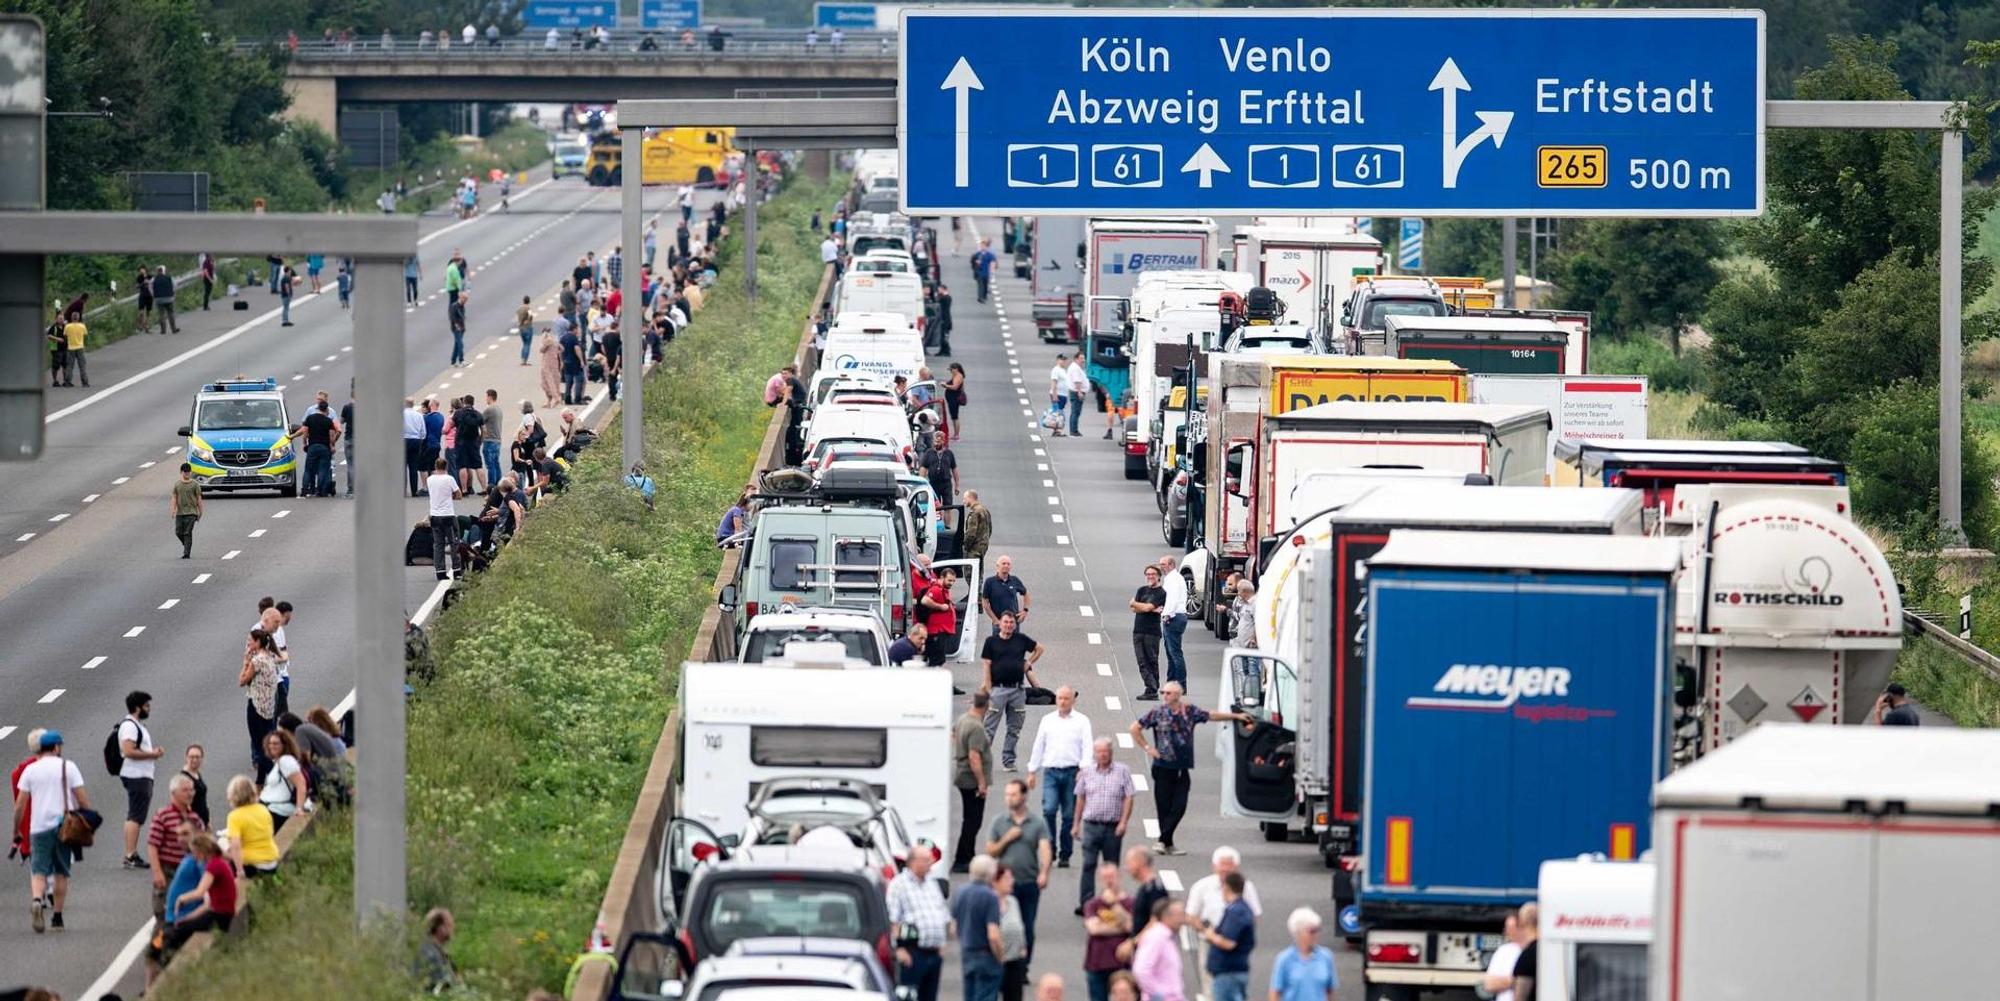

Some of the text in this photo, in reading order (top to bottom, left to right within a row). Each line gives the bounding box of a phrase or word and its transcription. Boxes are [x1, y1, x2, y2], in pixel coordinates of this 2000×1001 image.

[1081, 36, 1331, 73] Köln Venlo
[1536, 78, 1714, 113] Erftstadt
[1047, 89, 1365, 134] Abzweig Erfttal
[1038, 153, 1048, 178] 1
[1113, 153, 1141, 178] 61
[1278, 154, 1289, 179] 1
[1354, 154, 1382, 179] 61
[1547, 154, 1598, 179] 265
[1629, 159, 1731, 189] 500 m
[1128, 253, 1198, 270] BERTRAM
[1282, 252, 1301, 260] 2015
[1268, 276, 1300, 285] mazo
[1511, 349, 1536, 358] 10164
[1715, 590, 1845, 606] ROTHSCHILD
